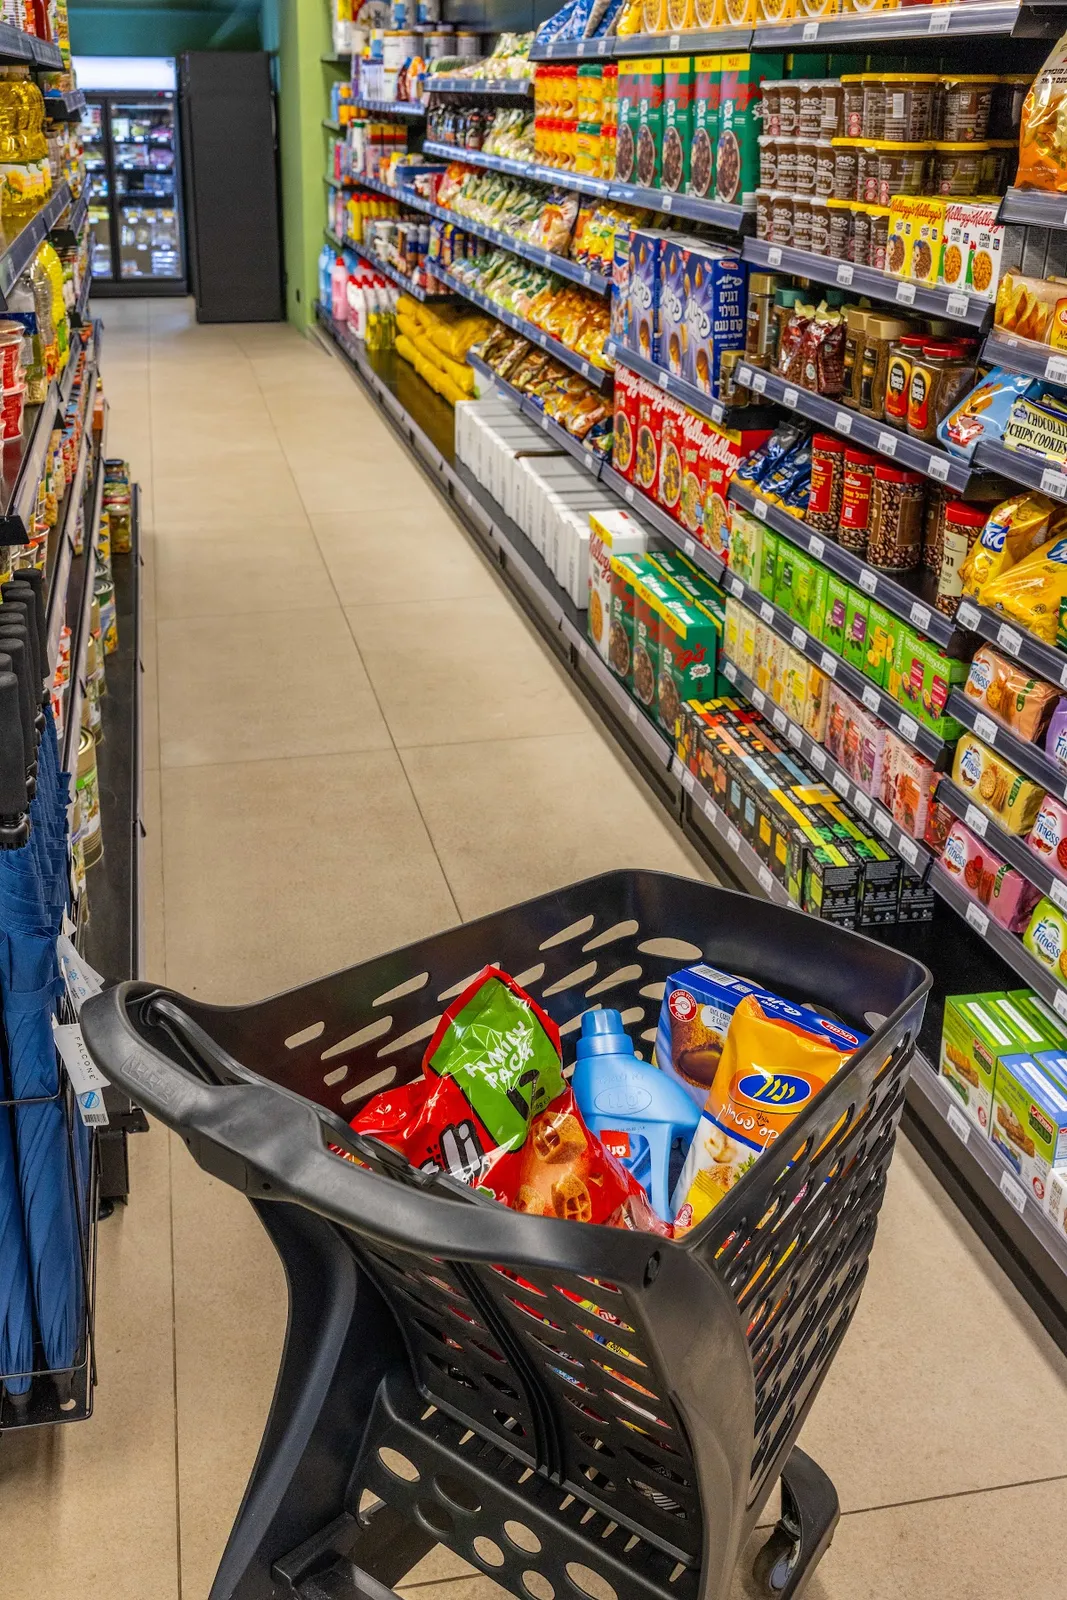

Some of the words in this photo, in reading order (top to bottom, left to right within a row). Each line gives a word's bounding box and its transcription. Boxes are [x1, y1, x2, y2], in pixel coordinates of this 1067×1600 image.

[980, 233, 990, 241] CORN
[1009, 423, 1035, 443] CHIPS
[1033, 431, 1067, 455] COOKIES
[960, 750, 982, 780] Fitness
[1036, 812, 1060, 846] Fitness
[945, 838, 967, 869] Fitness
[1033, 922, 1062, 958] Fitness
[75, 1036, 96, 1080] FALCONE
[463, 1020, 528, 1078] FAMILY
[484, 1040, 535, 1089] PACK
